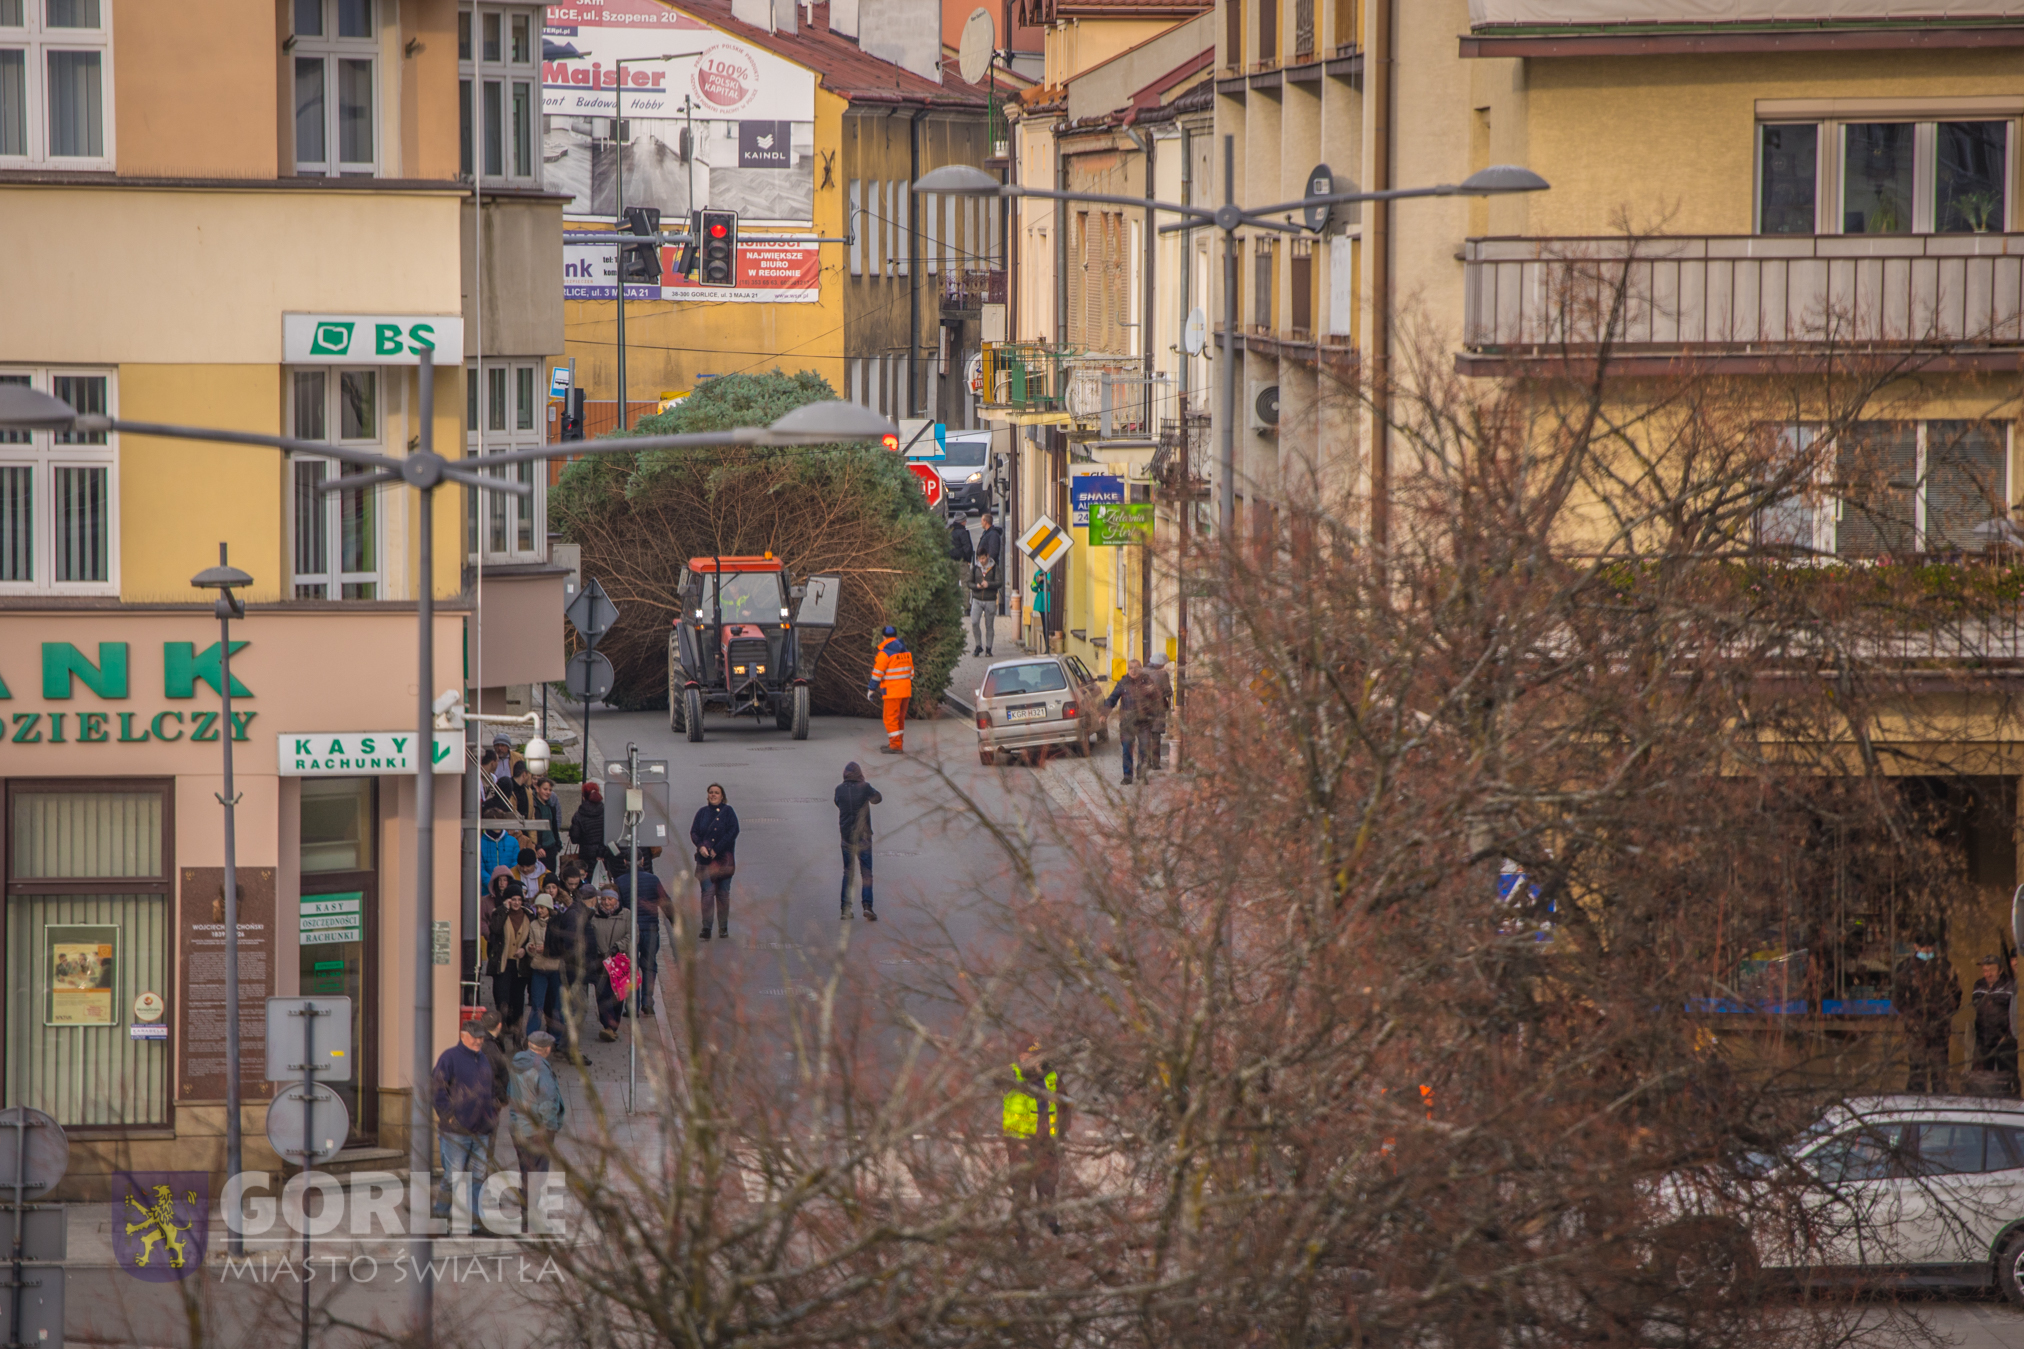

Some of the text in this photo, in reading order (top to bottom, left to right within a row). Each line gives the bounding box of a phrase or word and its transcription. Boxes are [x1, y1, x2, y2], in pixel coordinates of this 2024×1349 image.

[547, 8, 676, 24] LICE, ul. Szopena 20
[543, 62, 665, 90] Majster
[708, 58, 748, 80] 100%
[709, 75, 739, 89] POLSKI
[704, 83, 738, 99] KAPITAŁ
[631, 98, 664, 110] Hobby
[744, 152, 786, 160] KAINDL
[746, 252, 803, 260] NAJWIĘKSZE
[375, 323, 435, 356] BS
[0, 641, 254, 699] NK
[0, 711, 257, 742] ZIELCZY
[295, 738, 408, 755] KASY
[296, 758, 406, 769] RACHUNKI
[315, 903, 344, 912] KASY
[302, 915, 357, 928] OSZCZĘDNOŚCI
[306, 932, 354, 942] RACHUNKI
